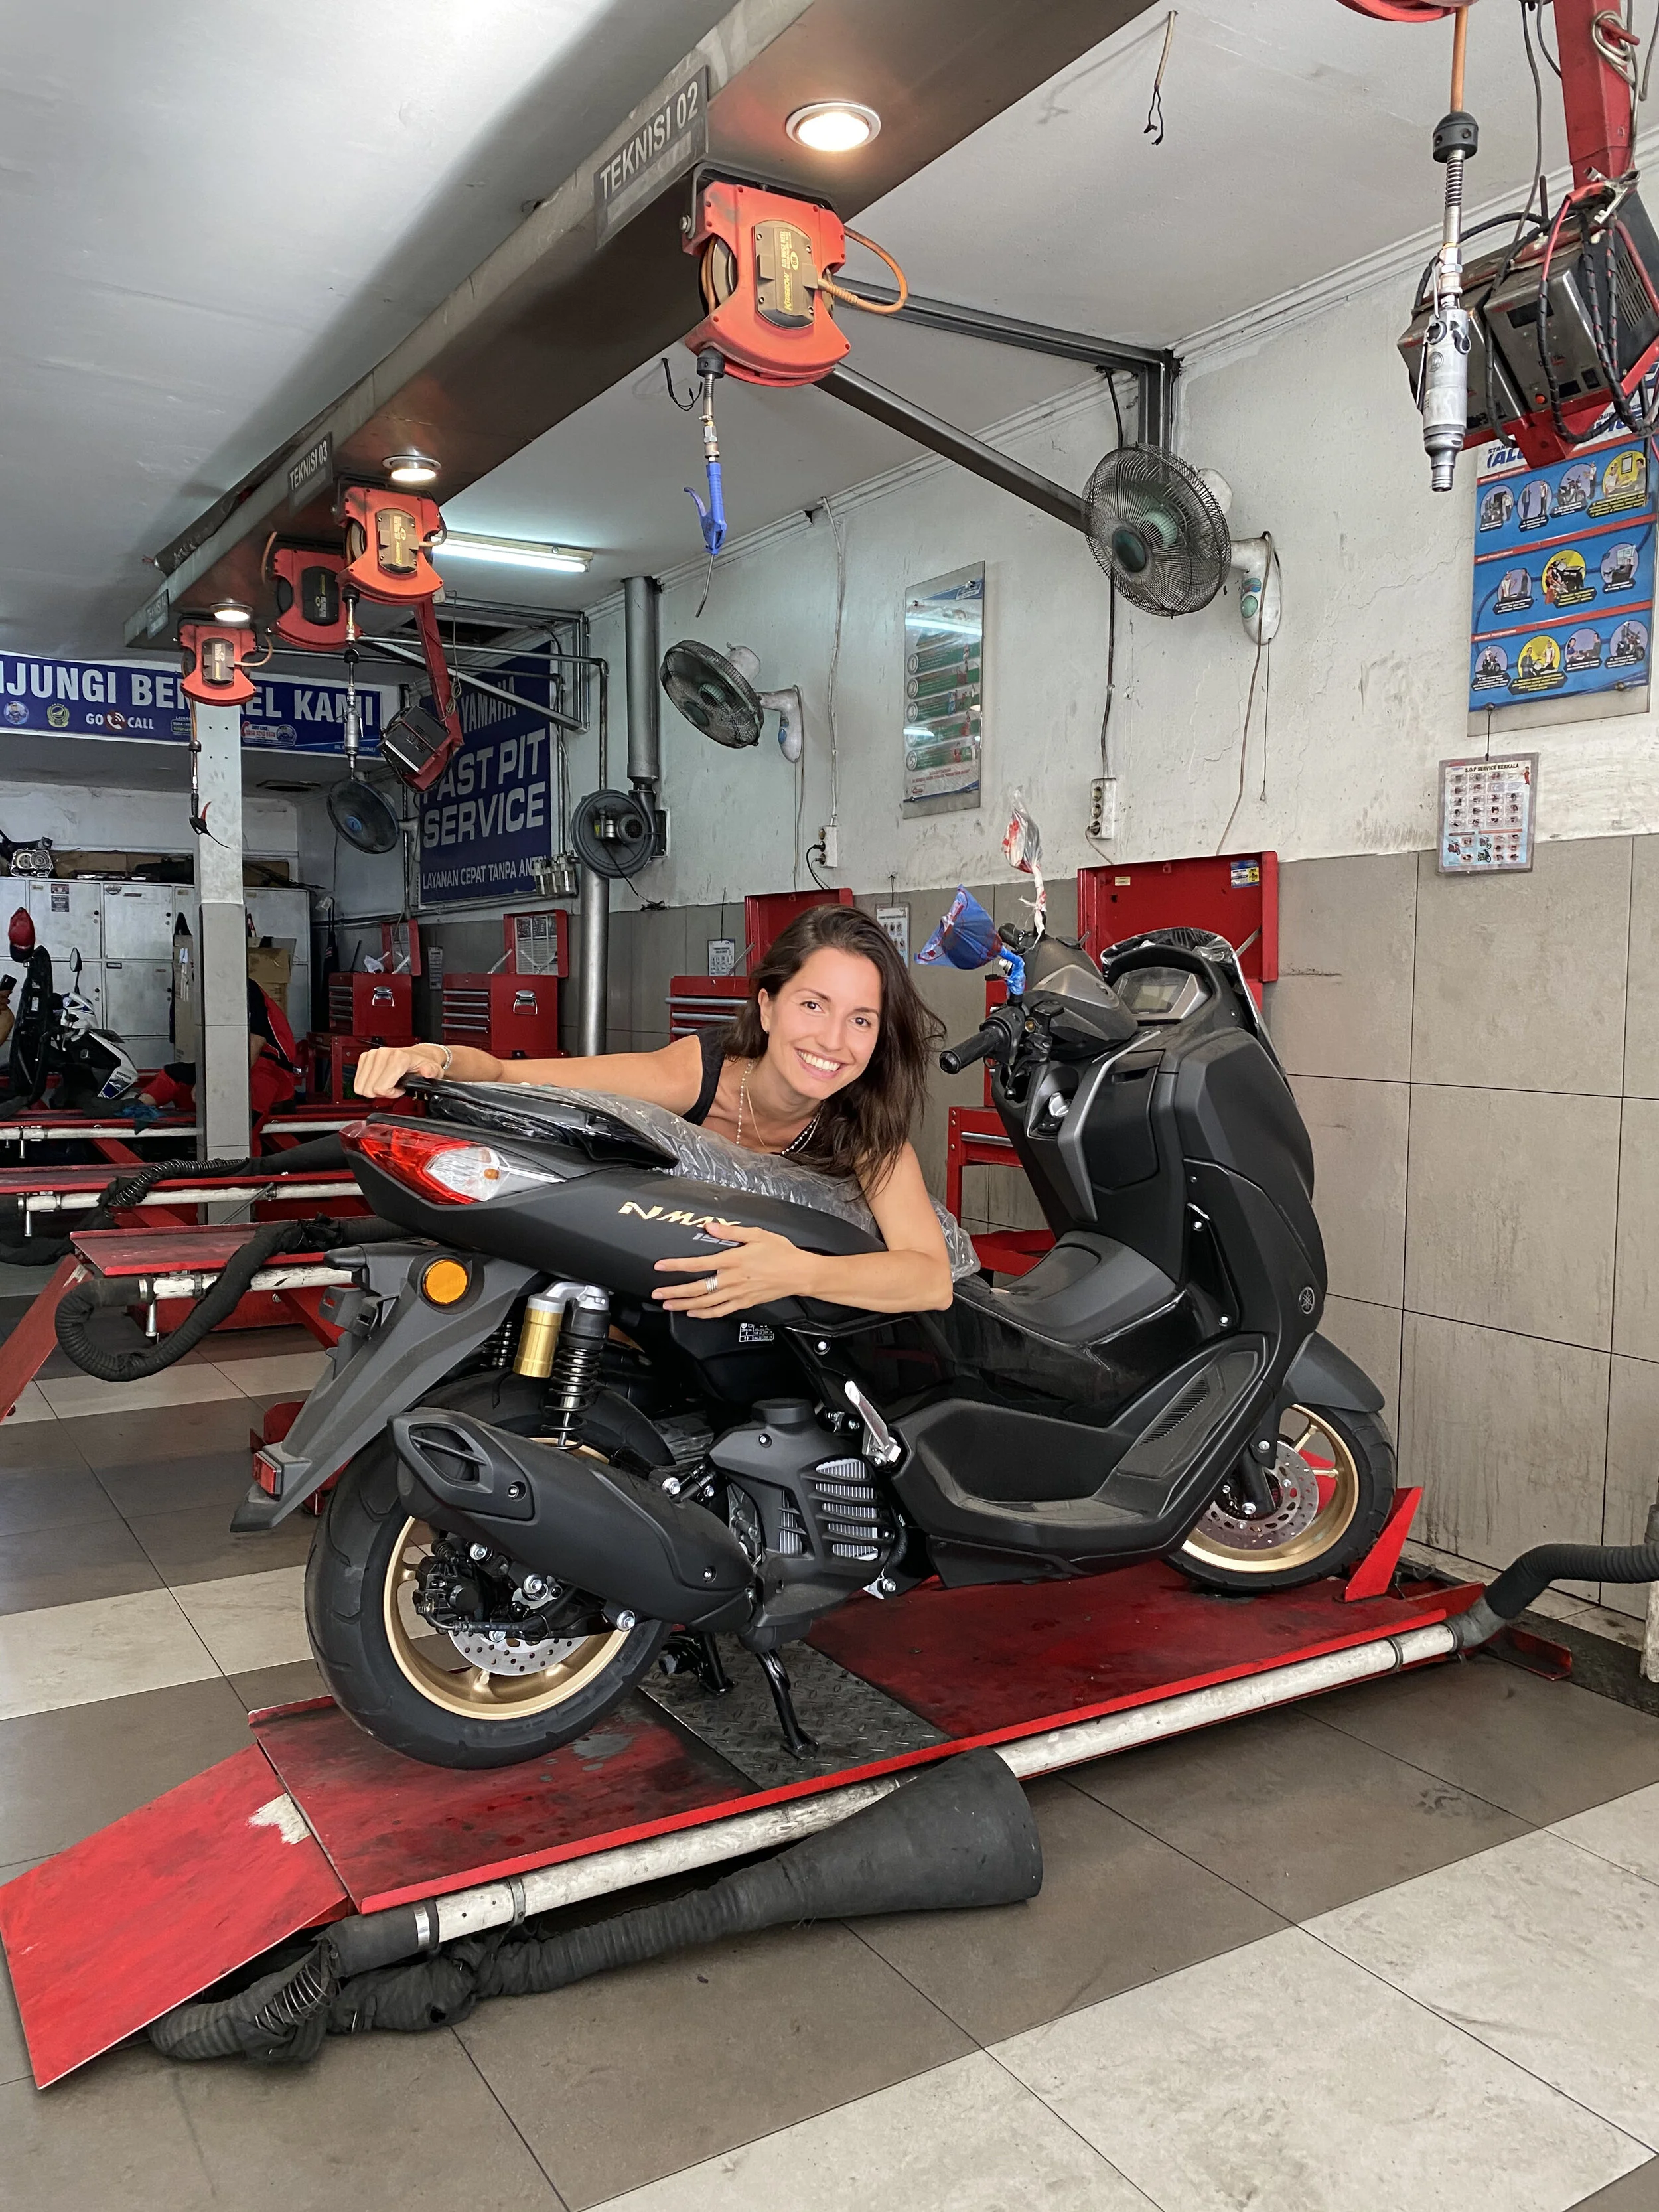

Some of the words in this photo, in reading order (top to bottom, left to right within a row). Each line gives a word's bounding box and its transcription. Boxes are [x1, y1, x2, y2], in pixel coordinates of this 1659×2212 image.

[600, 106, 670, 200] TEKNISI
[676, 81, 698, 129] 02
[784, 271, 793, 311] KRISBOW
[289, 448, 317, 491] TEKNISI
[319, 440, 328, 465] 03
[86, 713, 104, 725] GO
[127, 717, 154, 730] CALL
[461, 676, 516, 734] YAMAHA
[423, 746, 494, 804] AST
[498, 728, 546, 784] PIT
[423, 781, 546, 849] SERVICE
[423, 869, 458, 889] LAYANAN
[460, 864, 486, 885] CEPAT
[488, 861, 517, 881] TANPA
